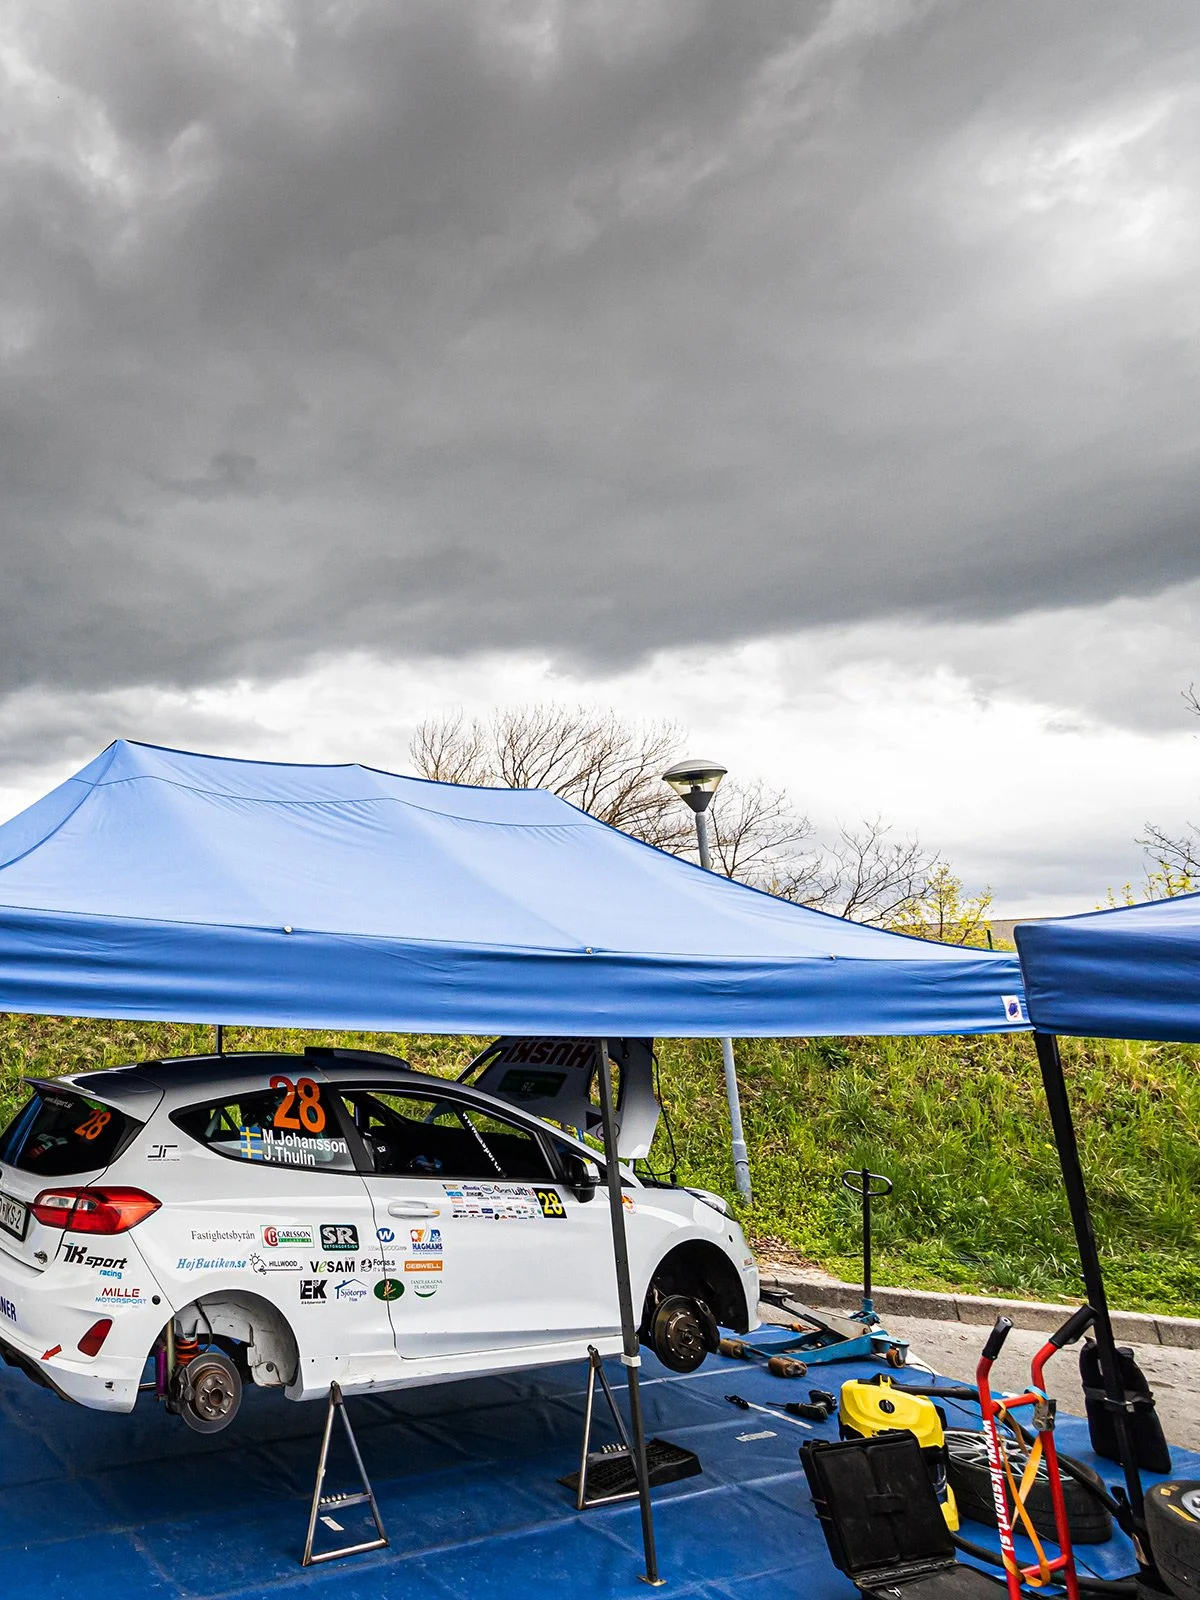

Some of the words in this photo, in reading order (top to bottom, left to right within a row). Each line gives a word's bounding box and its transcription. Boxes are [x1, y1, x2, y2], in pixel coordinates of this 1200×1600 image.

[269, 1075, 326, 1133] 28
[74, 1108, 111, 1140] 28
[262, 1128, 347, 1154] M.Johansson
[264, 1145, 316, 1166] J.Thulin
[538, 1192, 563, 1215] 28
[191, 1230, 256, 1242] Fastighetsbyrån
[277, 1230, 311, 1238] CARLSSON
[322, 1227, 357, 1244] SR
[378, 1229, 393, 1240] W
[84, 1256, 128, 1269] sport
[176, 1258, 247, 1271] HojButiken.se
[309, 1260, 356, 1273] VeSAM
[99, 1269, 122, 1279] racing
[102, 1287, 141, 1297] MILLE
[300, 1280, 328, 1300] EK
[982, 1419, 1015, 1551] www.iksport.si
